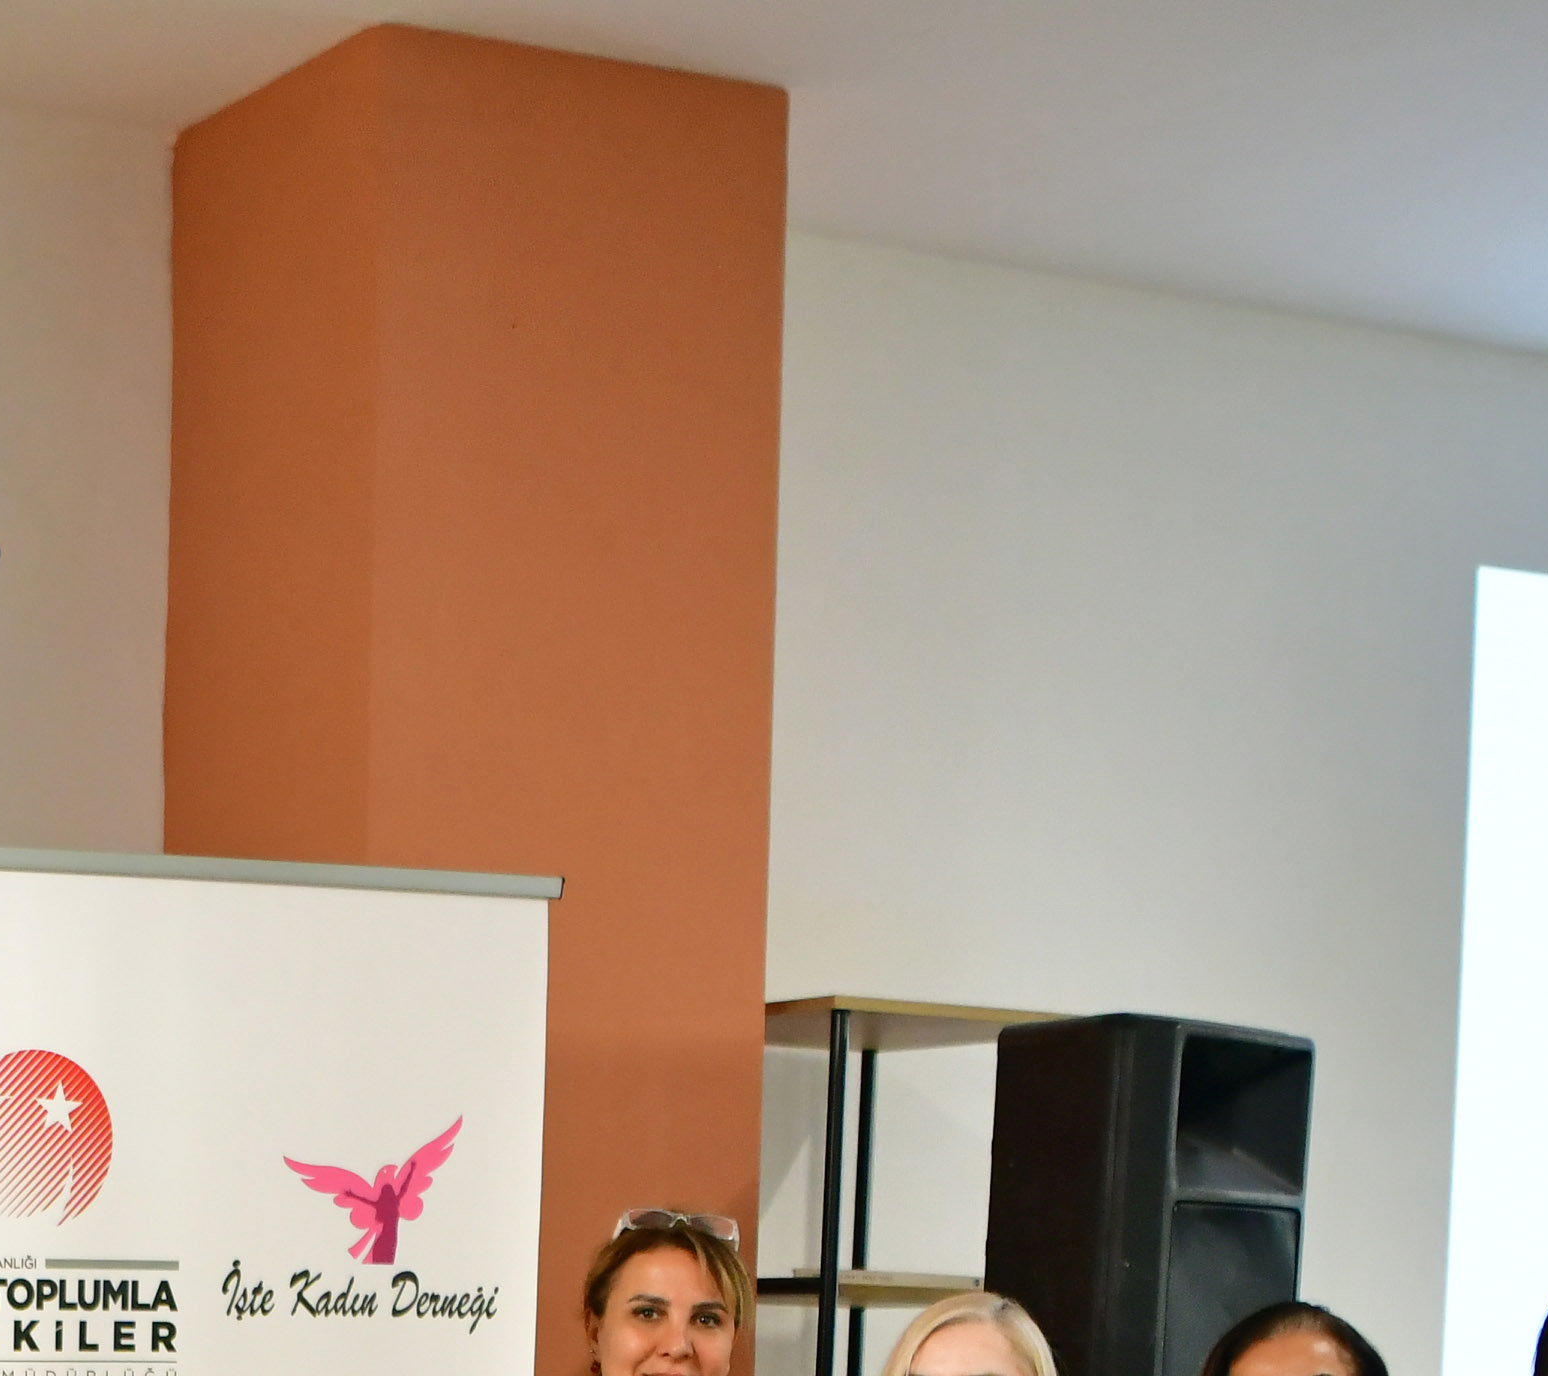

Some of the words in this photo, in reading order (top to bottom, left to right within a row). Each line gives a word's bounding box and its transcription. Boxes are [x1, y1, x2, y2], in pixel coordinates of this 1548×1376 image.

[222, 1259, 275, 1321] İşte
[289, 1269, 378, 1318] Kadın
[391, 1270, 500, 1334] Derneği
